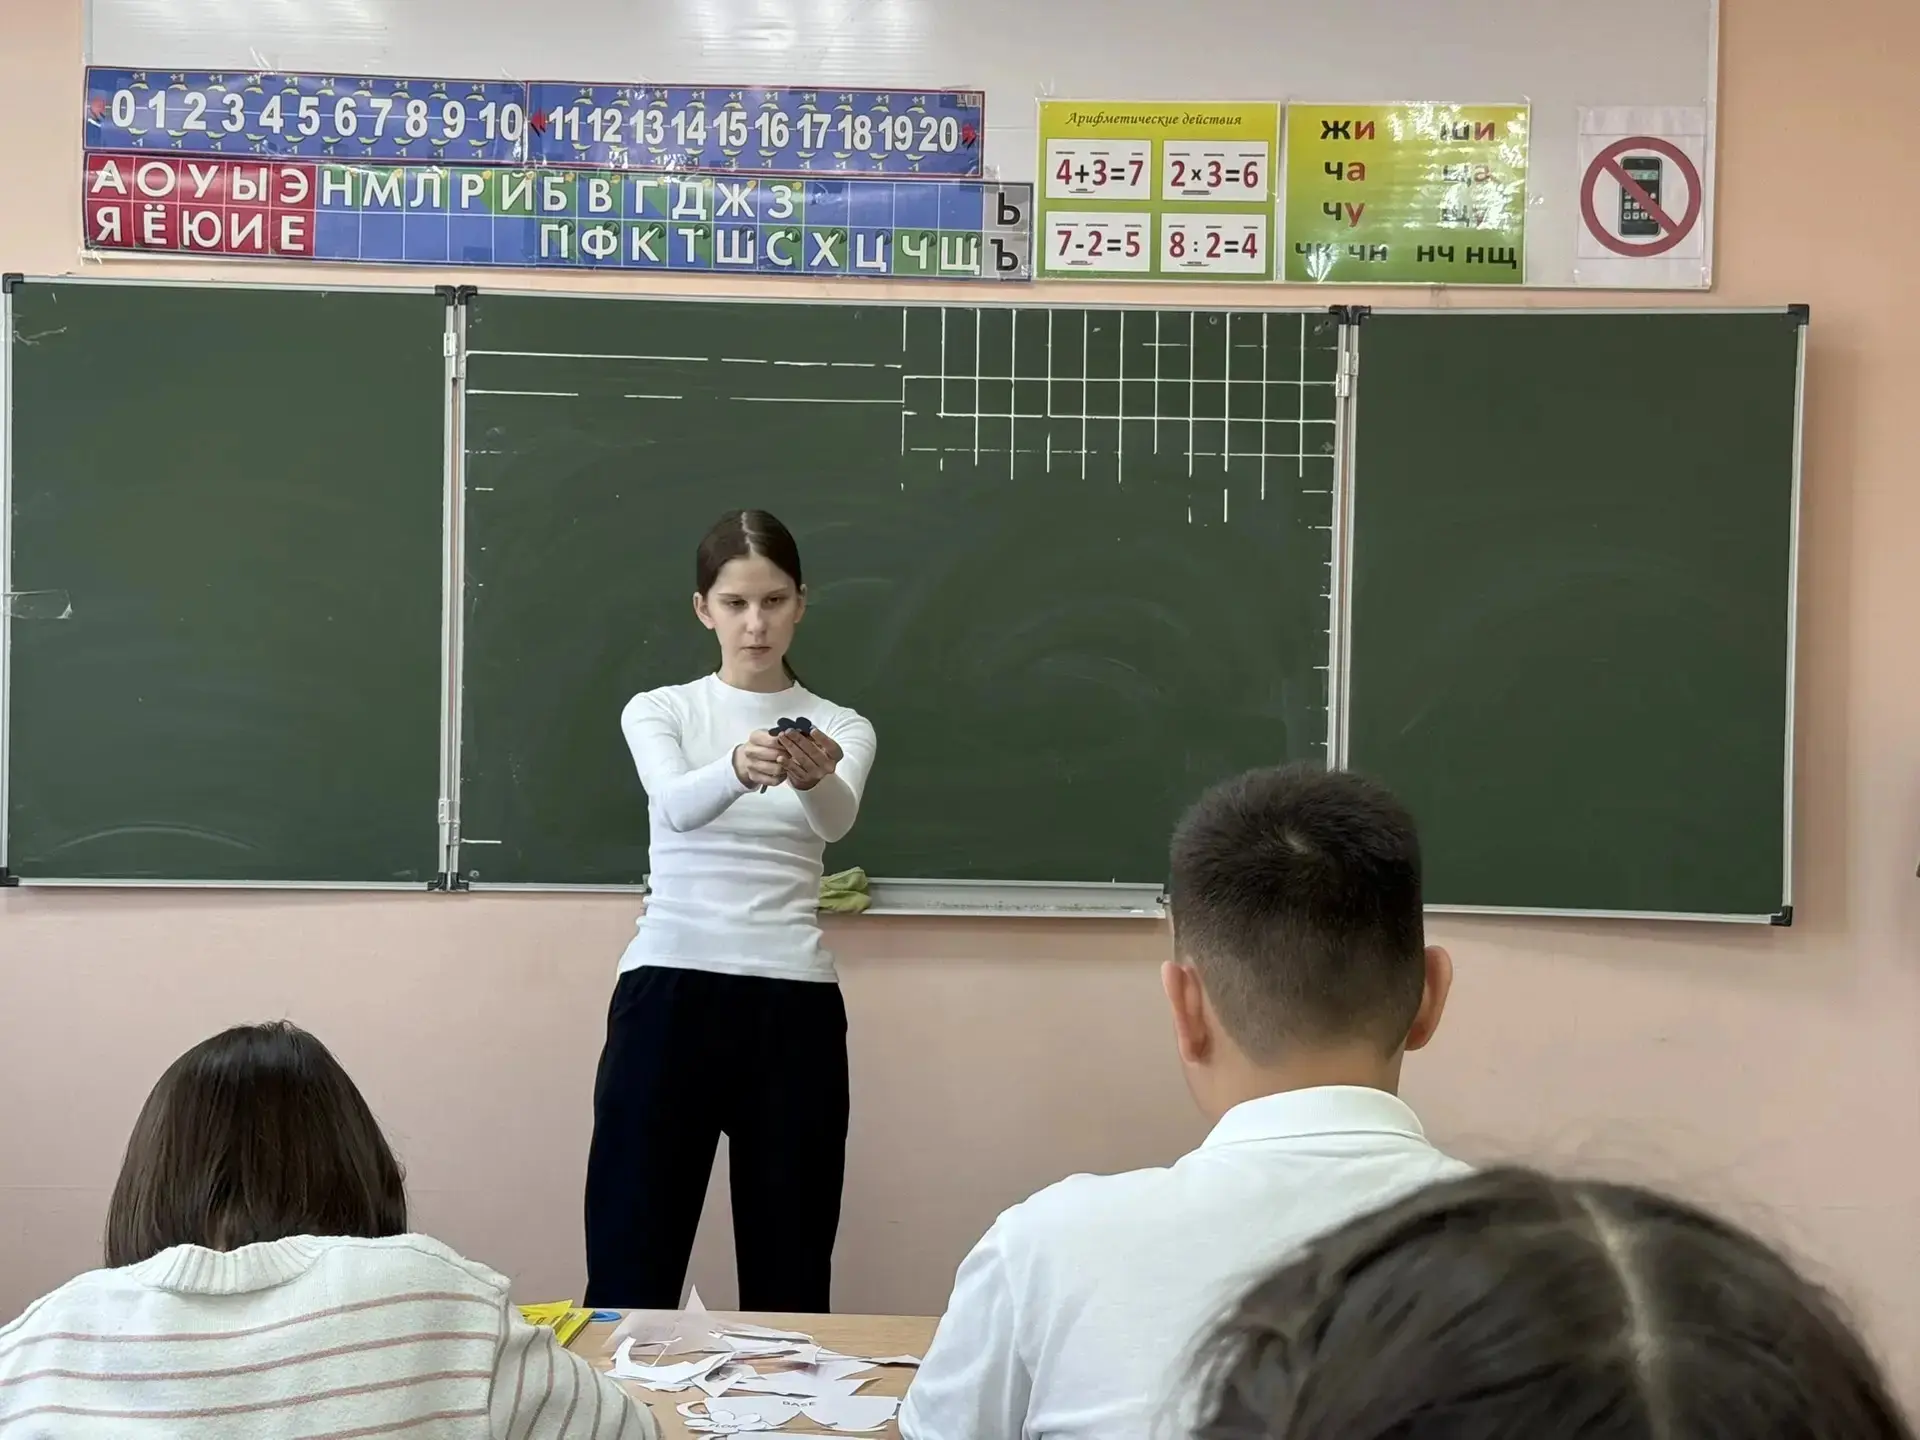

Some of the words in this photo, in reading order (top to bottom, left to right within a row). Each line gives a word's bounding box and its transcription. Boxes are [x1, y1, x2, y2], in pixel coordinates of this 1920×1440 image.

[112, 89, 135, 127] 0
[149, 91, 166, 128] 1
[183, 92, 206, 130] 2
[221, 93, 245, 132] 3
[259, 95, 284, 133] 4
[298, 96, 320, 135] 5
[335, 97, 357, 136] 6
[370, 98, 392, 136] 7
[405, 99, 428, 138] 8
[443, 100, 465, 139] 9
[479, 101, 523, 141] 10
[1065, 111, 1179, 127] Арифметические
[1182, 112, 1242, 126] действия
[549, 106, 580, 141] 11
[587, 108, 622, 143] 12
[630, 109, 664, 144] 13
[671, 110, 707, 146] 14
[713, 111, 748, 147] 15
[755, 112, 789, 148] 16
[797, 113, 831, 149] 17
[838, 114, 872, 150] 18
[879, 115, 913, 151] 19
[919, 116, 958, 152] 20
[1320, 120, 1375, 140] жи
[1056, 158, 1144, 187] 4+3=7
[1325, 161, 1365, 181] ча
[91, 160, 127, 194] А
[137, 161, 176, 197] О
[187, 164, 219, 198] У
[232, 166, 267, 201] Ы
[280, 168, 309, 204] Э
[322, 170, 353, 206] Н
[363, 171, 402, 207] М
[410, 172, 441, 208] Л
[461, 173, 485, 209] Р
[543, 176, 568, 211] Б
[589, 178, 613, 213] В
[635, 180, 659, 214] Г
[672, 181, 707, 221] Д
[716, 183, 755, 217] Ж
[768, 185, 794, 219] З
[997, 192, 1021, 226] Ь
[1323, 202, 1365, 227] чу
[96, 206, 121, 242] Я
[144, 203, 167, 244] Ё
[182, 210, 222, 248] Ю
[231, 213, 263, 249] И
[281, 215, 305, 251] Е
[541, 223, 569, 258] П
[581, 225, 618, 260] Ф
[632, 226, 660, 262] К
[677, 228, 705, 263] Т
[716, 229, 755, 264] Ш
[766, 230, 795, 267] С
[810, 232, 840, 267] Х
[856, 233, 887, 273] Ц
[902, 235, 928, 270] Ч
[941, 236, 980, 276] Щ
[990, 238, 1019, 271] Ъ
[1057, 230, 1141, 258] 7-2=5
[1349, 243, 1388, 262] чн
[1417, 245, 1454, 263] нч
[1466, 245, 1517, 269] нщ
[782, 1400, 817, 1408] BASE
